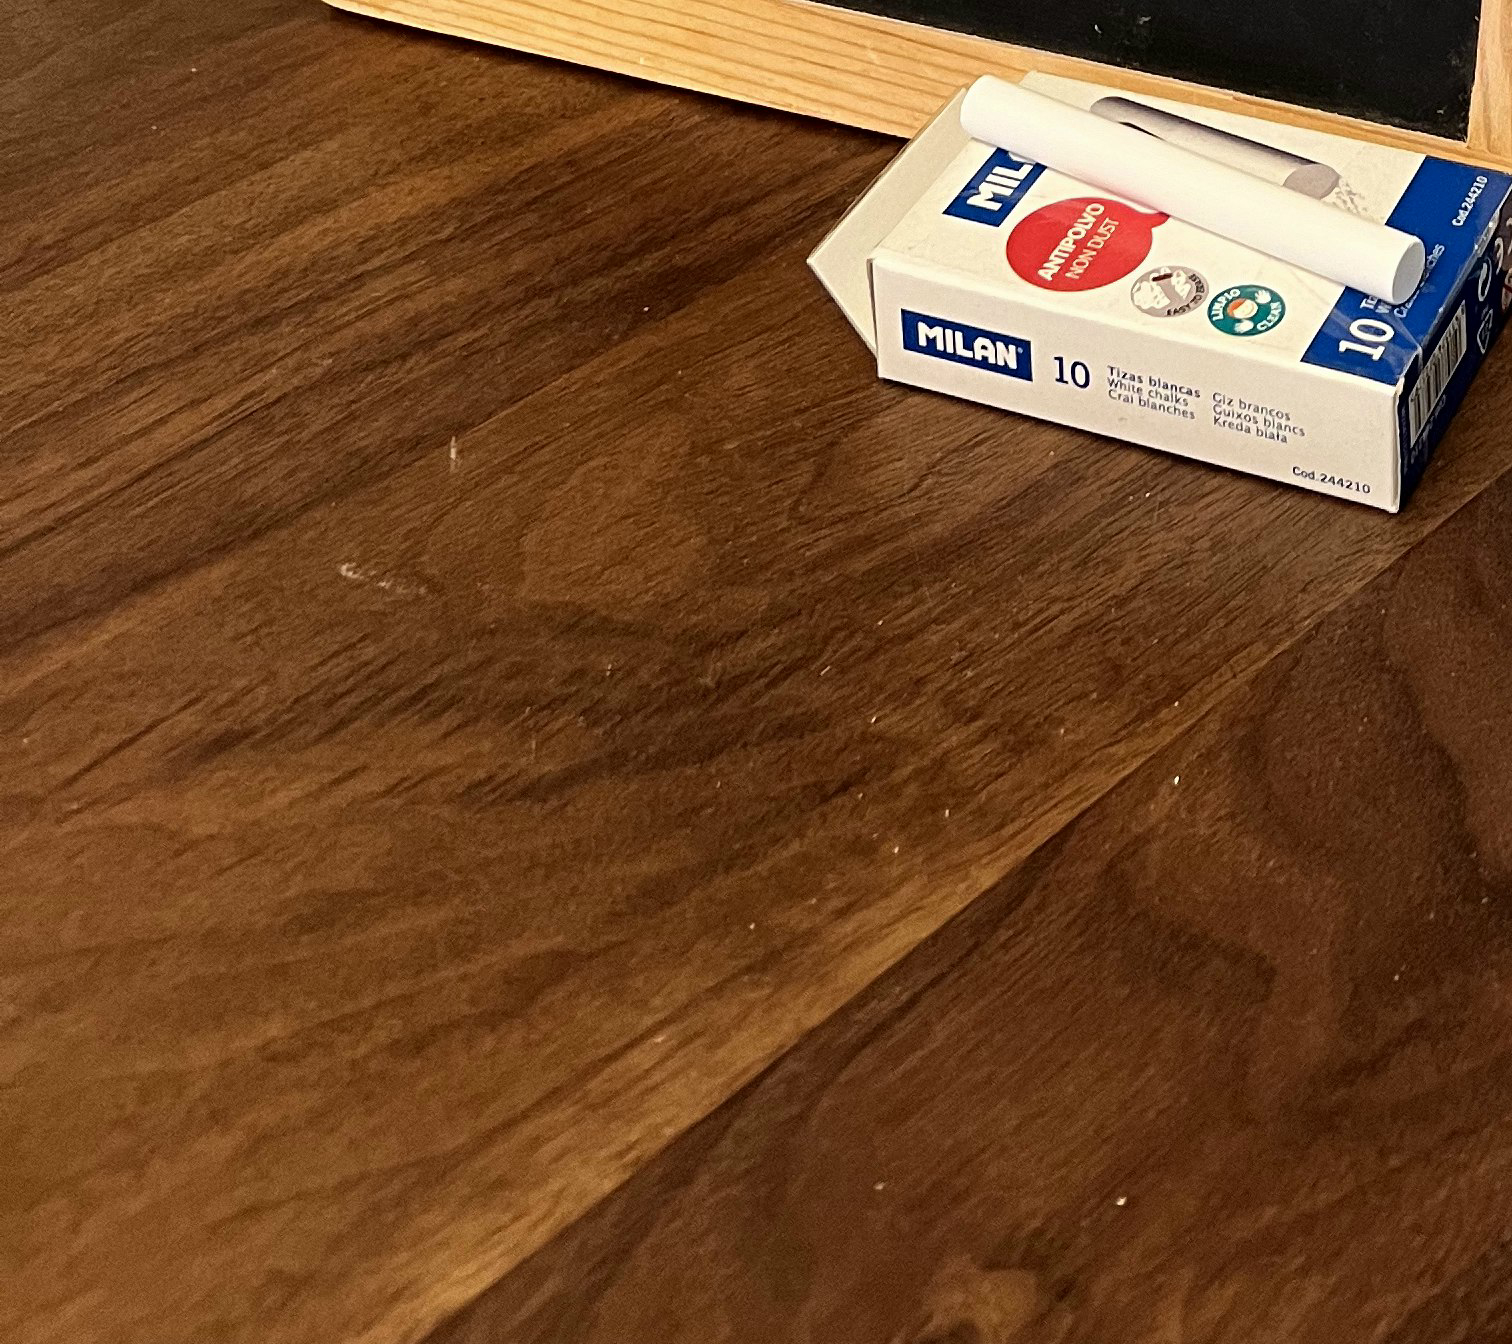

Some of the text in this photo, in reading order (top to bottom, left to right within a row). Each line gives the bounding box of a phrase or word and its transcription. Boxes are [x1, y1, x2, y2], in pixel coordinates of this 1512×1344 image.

[1037, 202, 1105, 281] ANTIPOLVO
[1064, 217, 1120, 280] NON DUST
[1211, 288, 1241, 321] LIMPIO
[1256, 301, 1282, 331] CLEAN
[1338, 318, 1395, 362] 10
[1053, 356, 1091, 389] 10
[1106, 365, 1201, 398] Tizas blancas
[1107, 376, 1189, 407] White chalks
[1138, 394, 1196, 420] blanches
[1212, 392, 1291, 421] Giz brancos
[1213, 415, 1251, 434] Kreda
[1263, 417, 1306, 437] blancs
[1292, 466, 1371, 494] Cod.244210
